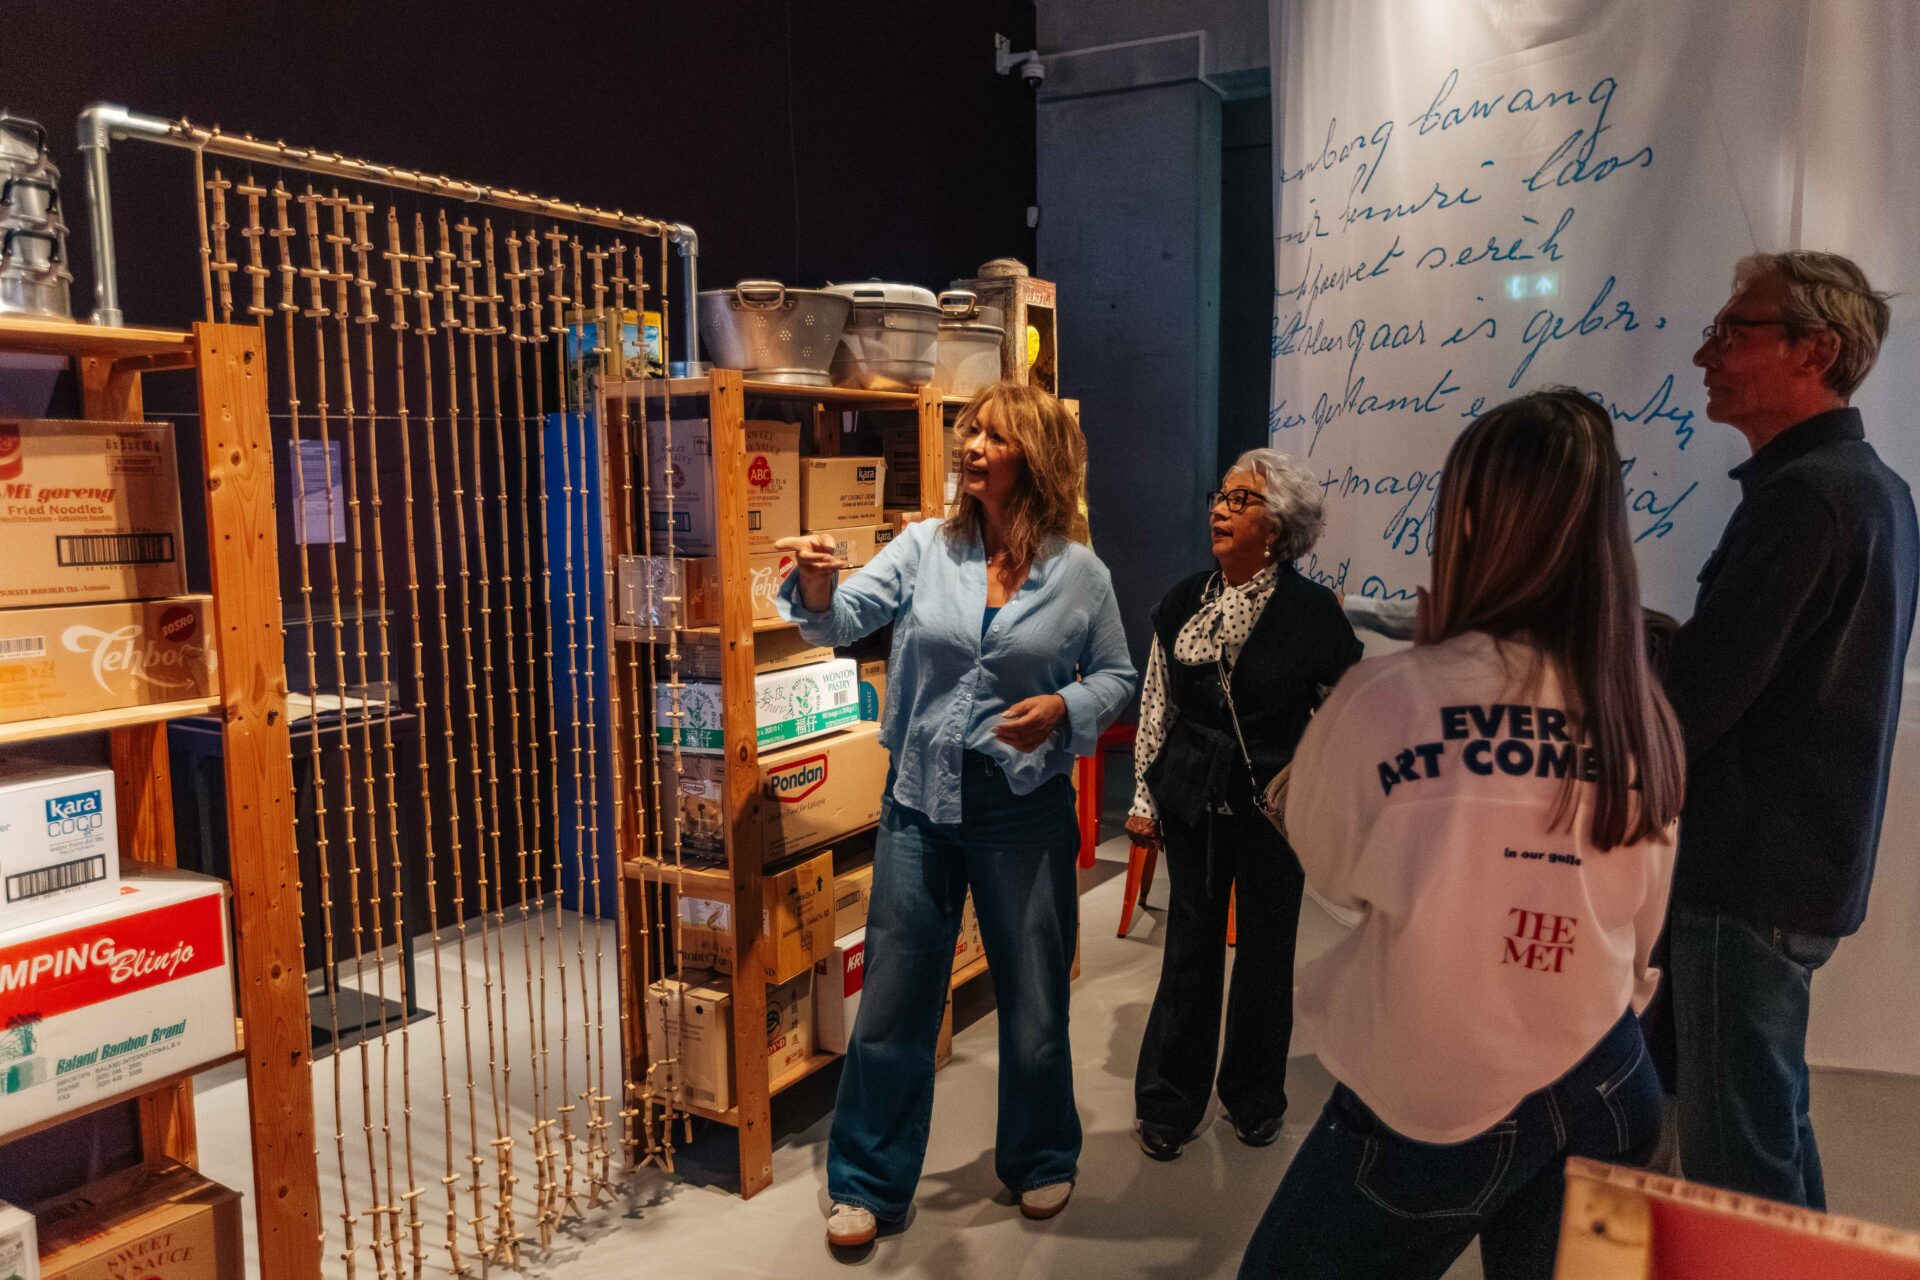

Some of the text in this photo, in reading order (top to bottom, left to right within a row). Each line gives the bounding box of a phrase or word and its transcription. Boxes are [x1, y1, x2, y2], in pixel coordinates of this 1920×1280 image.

[750, 468, 770, 481] ABC
[858, 467, 875, 480] kara
[37, 487, 116, 504] goreng
[7, 504, 104, 515] Fried Noodles
[876, 530, 892, 543] kara
[162, 613, 194, 637] SOSRO
[822, 668, 856, 683] WONTON
[827, 680, 851, 692] PASTRY
[1439, 704, 1569, 742] EVER
[771, 766, 823, 795] Pondan
[1377, 741, 1444, 797] ART
[682, 782, 705, 795] Pondan
[50, 797, 97, 819] kara
[48, 812, 103, 837] COCO
[1504, 848, 1582, 866] in our galle
[1508, 907, 1577, 944] THE
[109, 940, 195, 984] Blinjo
[1501, 935, 1574, 973] MET
[101, 1034, 149, 1061] Bamboo
[151, 1018, 187, 1044] Brand
[107, 1233, 176, 1269] SWEET
[132, 1246, 195, 1276] SAUCE
